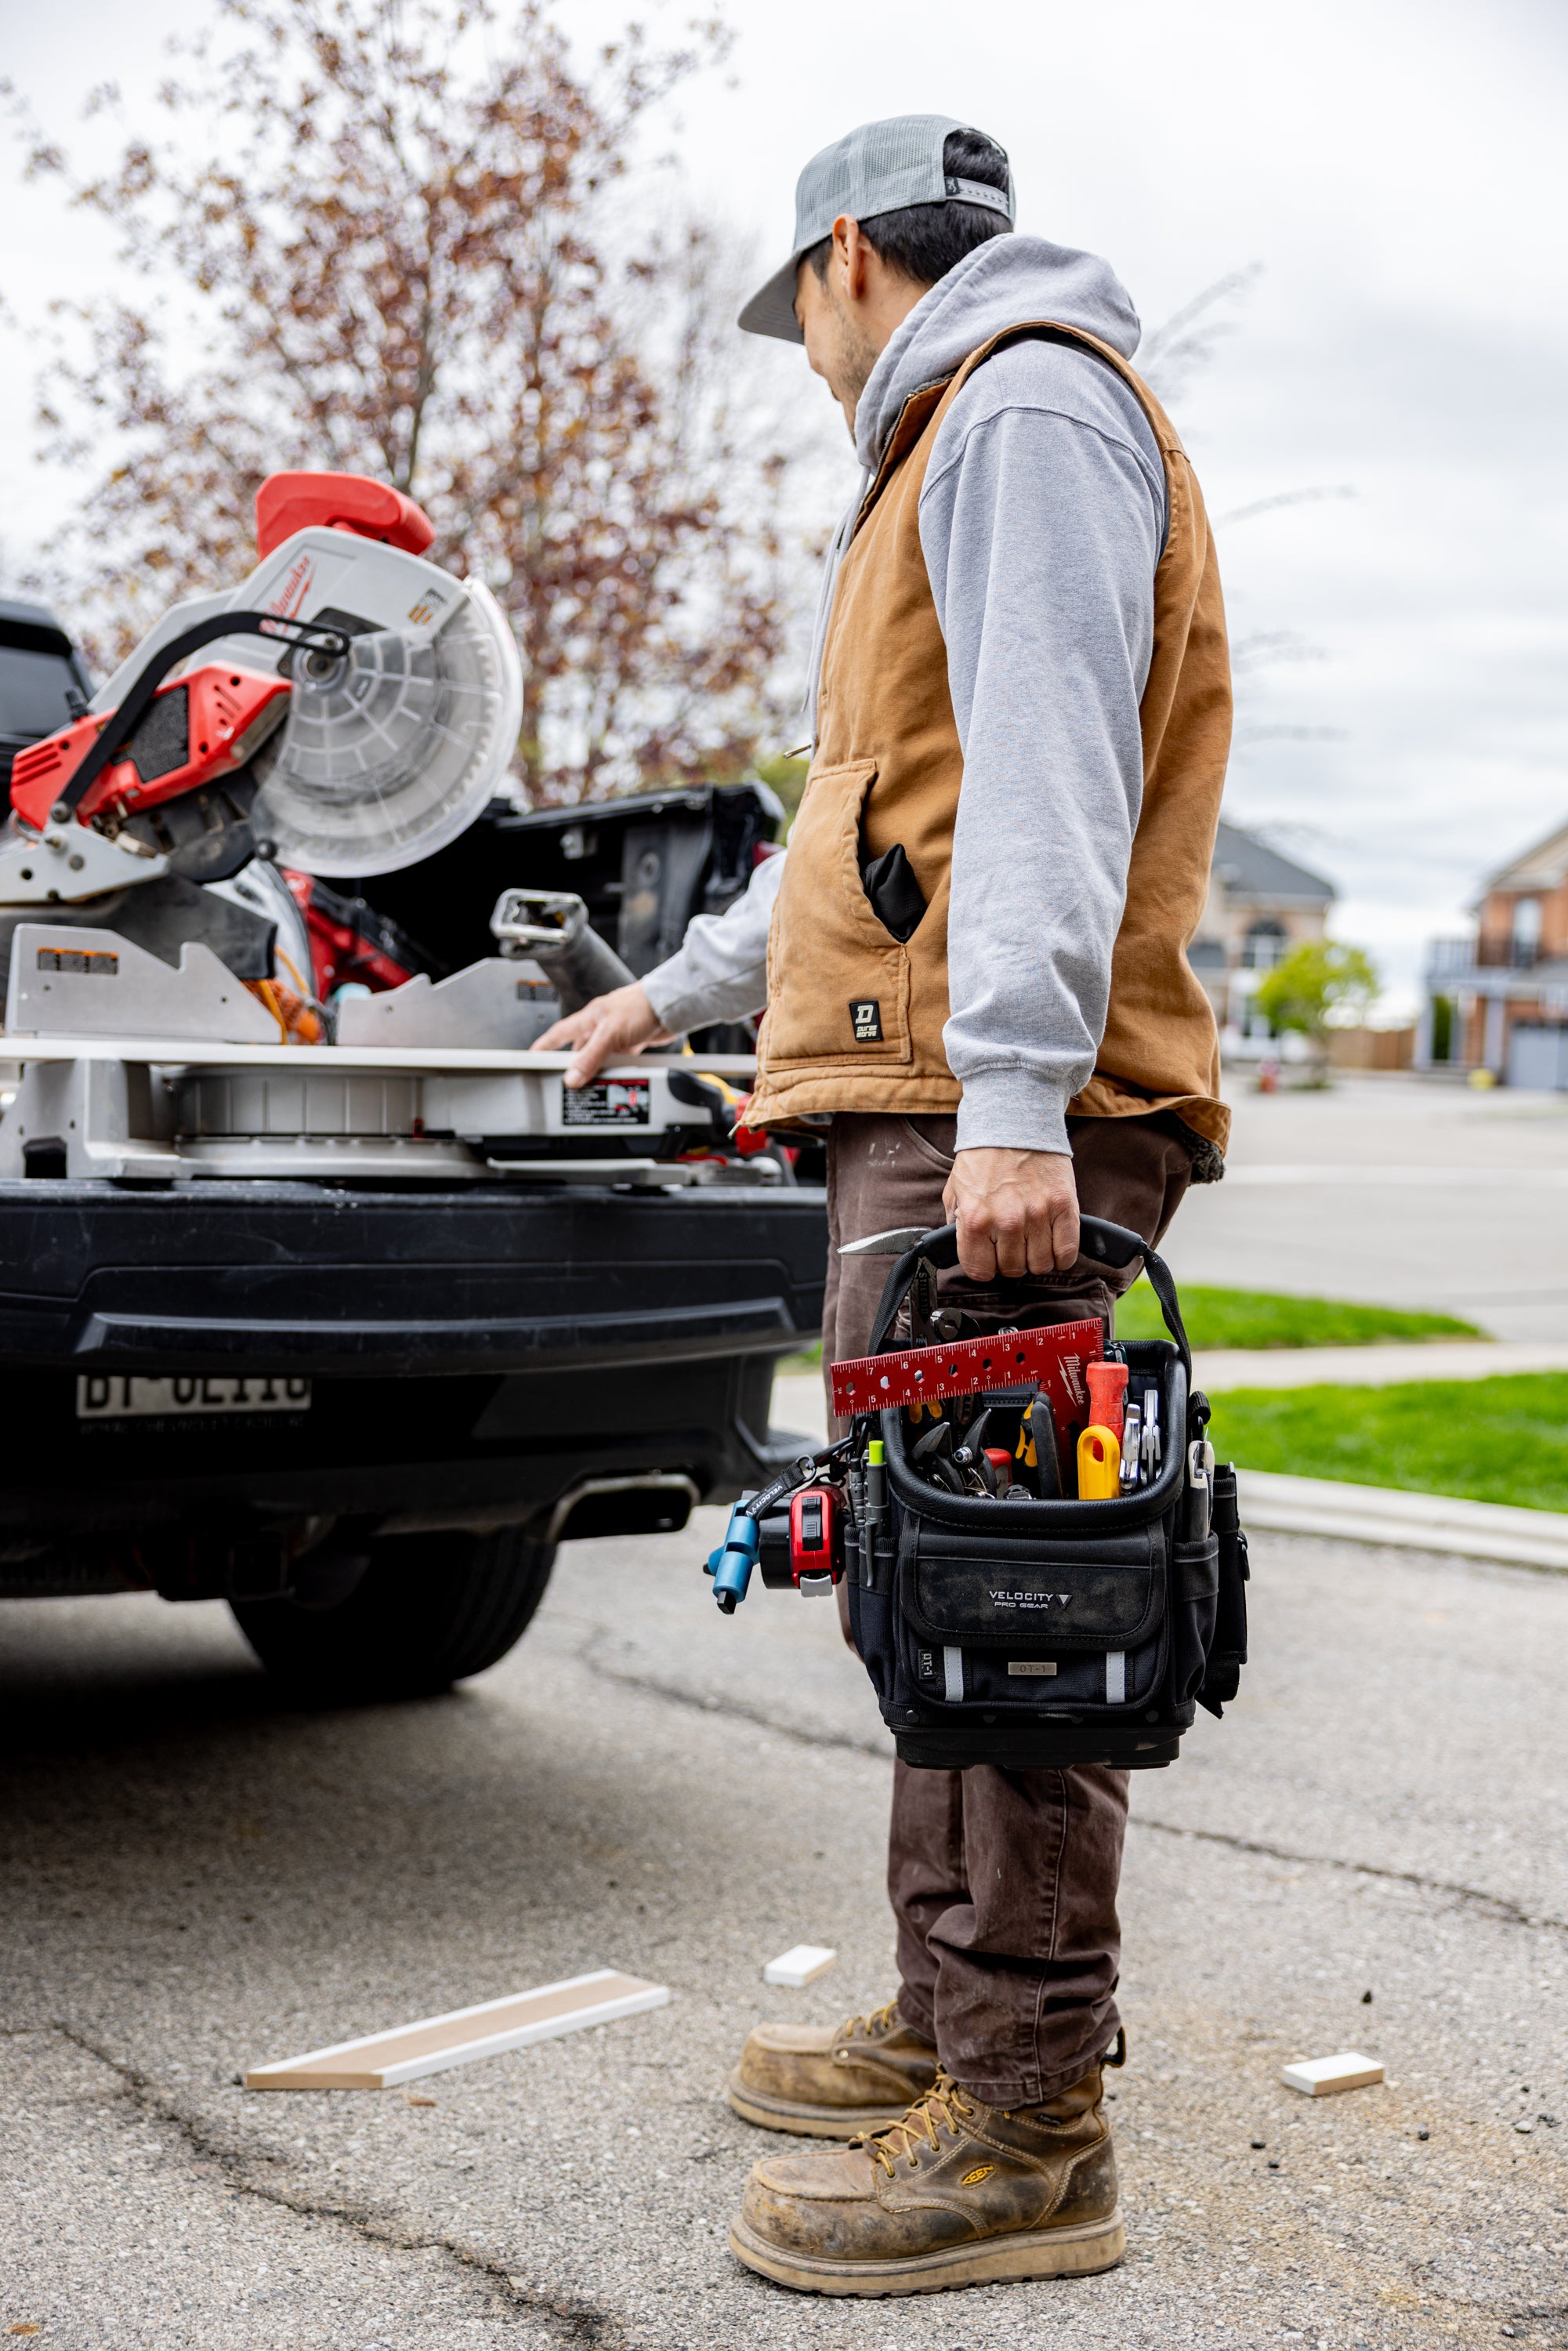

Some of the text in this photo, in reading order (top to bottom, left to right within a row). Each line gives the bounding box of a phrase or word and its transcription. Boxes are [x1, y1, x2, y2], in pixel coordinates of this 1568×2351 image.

[855, 1005, 874, 1023] D
[918, 1272, 929, 1314] STILETTO
[868, 1367, 874, 1375] 7
[1063, 1353, 1086, 1405] Milwaukee
[752, 1485, 783, 1514] VELOCITY
[989, 1591, 1053, 1602] VELOCITY
[923, 1653, 932, 1675] OT-1
[1019, 1665, 1046, 1673] OT-1
[961, 2164, 994, 2186] KEEN
